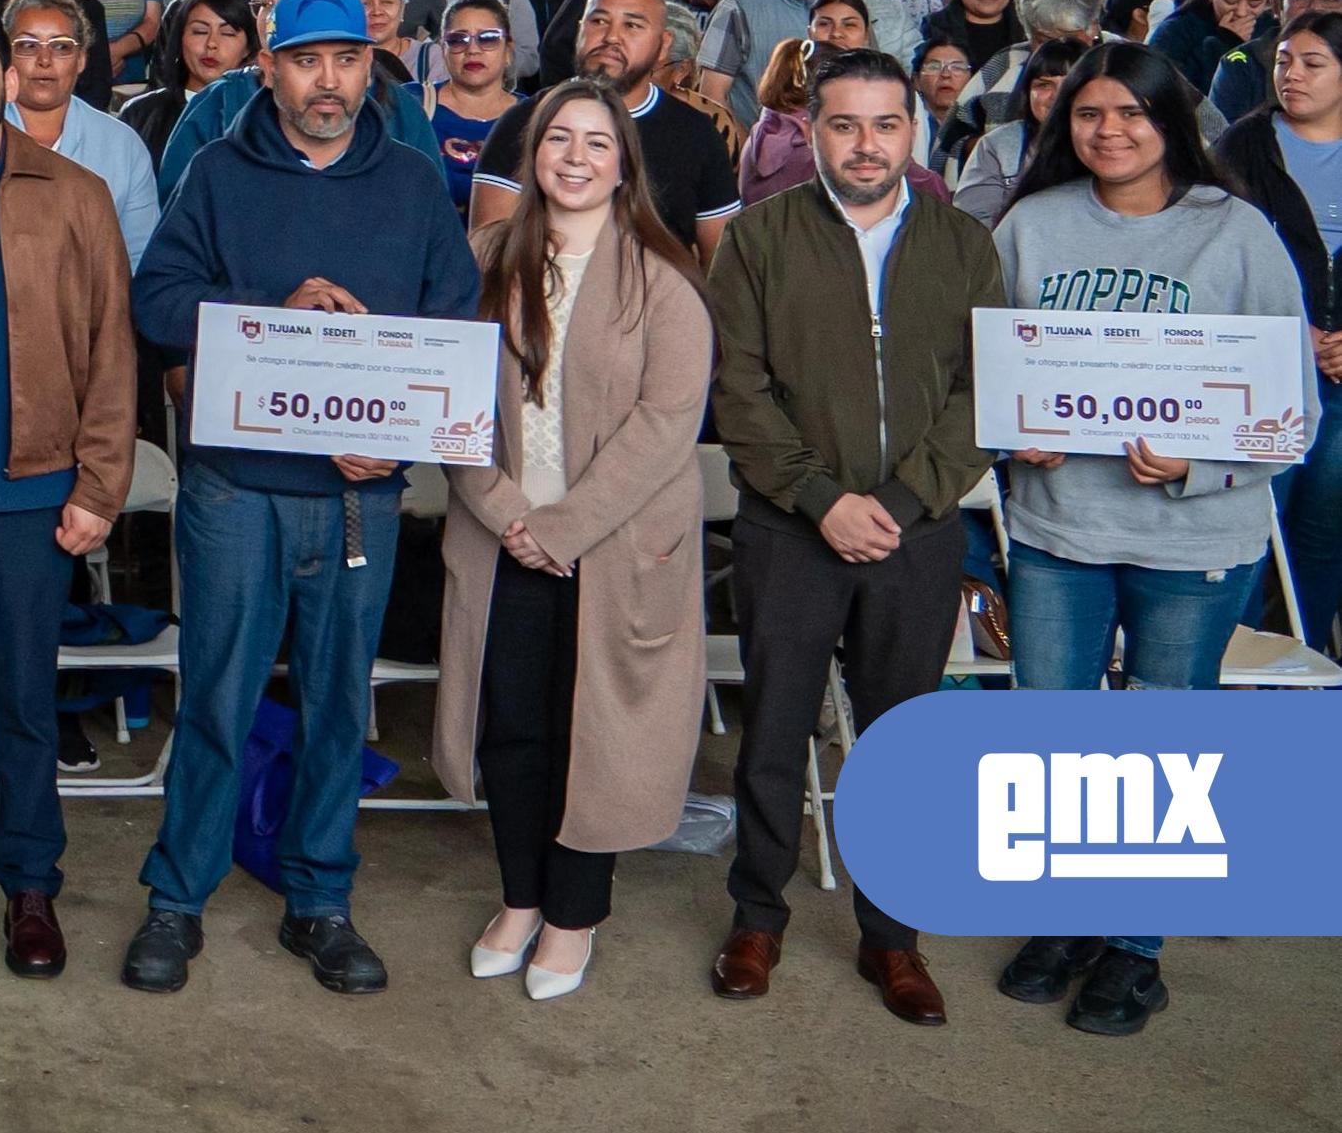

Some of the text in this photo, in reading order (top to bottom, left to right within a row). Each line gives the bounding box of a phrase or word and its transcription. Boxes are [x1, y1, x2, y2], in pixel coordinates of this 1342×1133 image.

[268, 322, 313, 334] TIJUANA
[323, 326, 358, 337] SEDETI
[1045, 325, 1093, 335] TIJUANA
[1104, 327, 1141, 337] SEDETI
[1164, 327, 1204, 336] FONDOS
[378, 329, 414, 339] FONDOS
[388, 416, 420, 427] pesos
[1185, 415, 1220, 426] pesos
